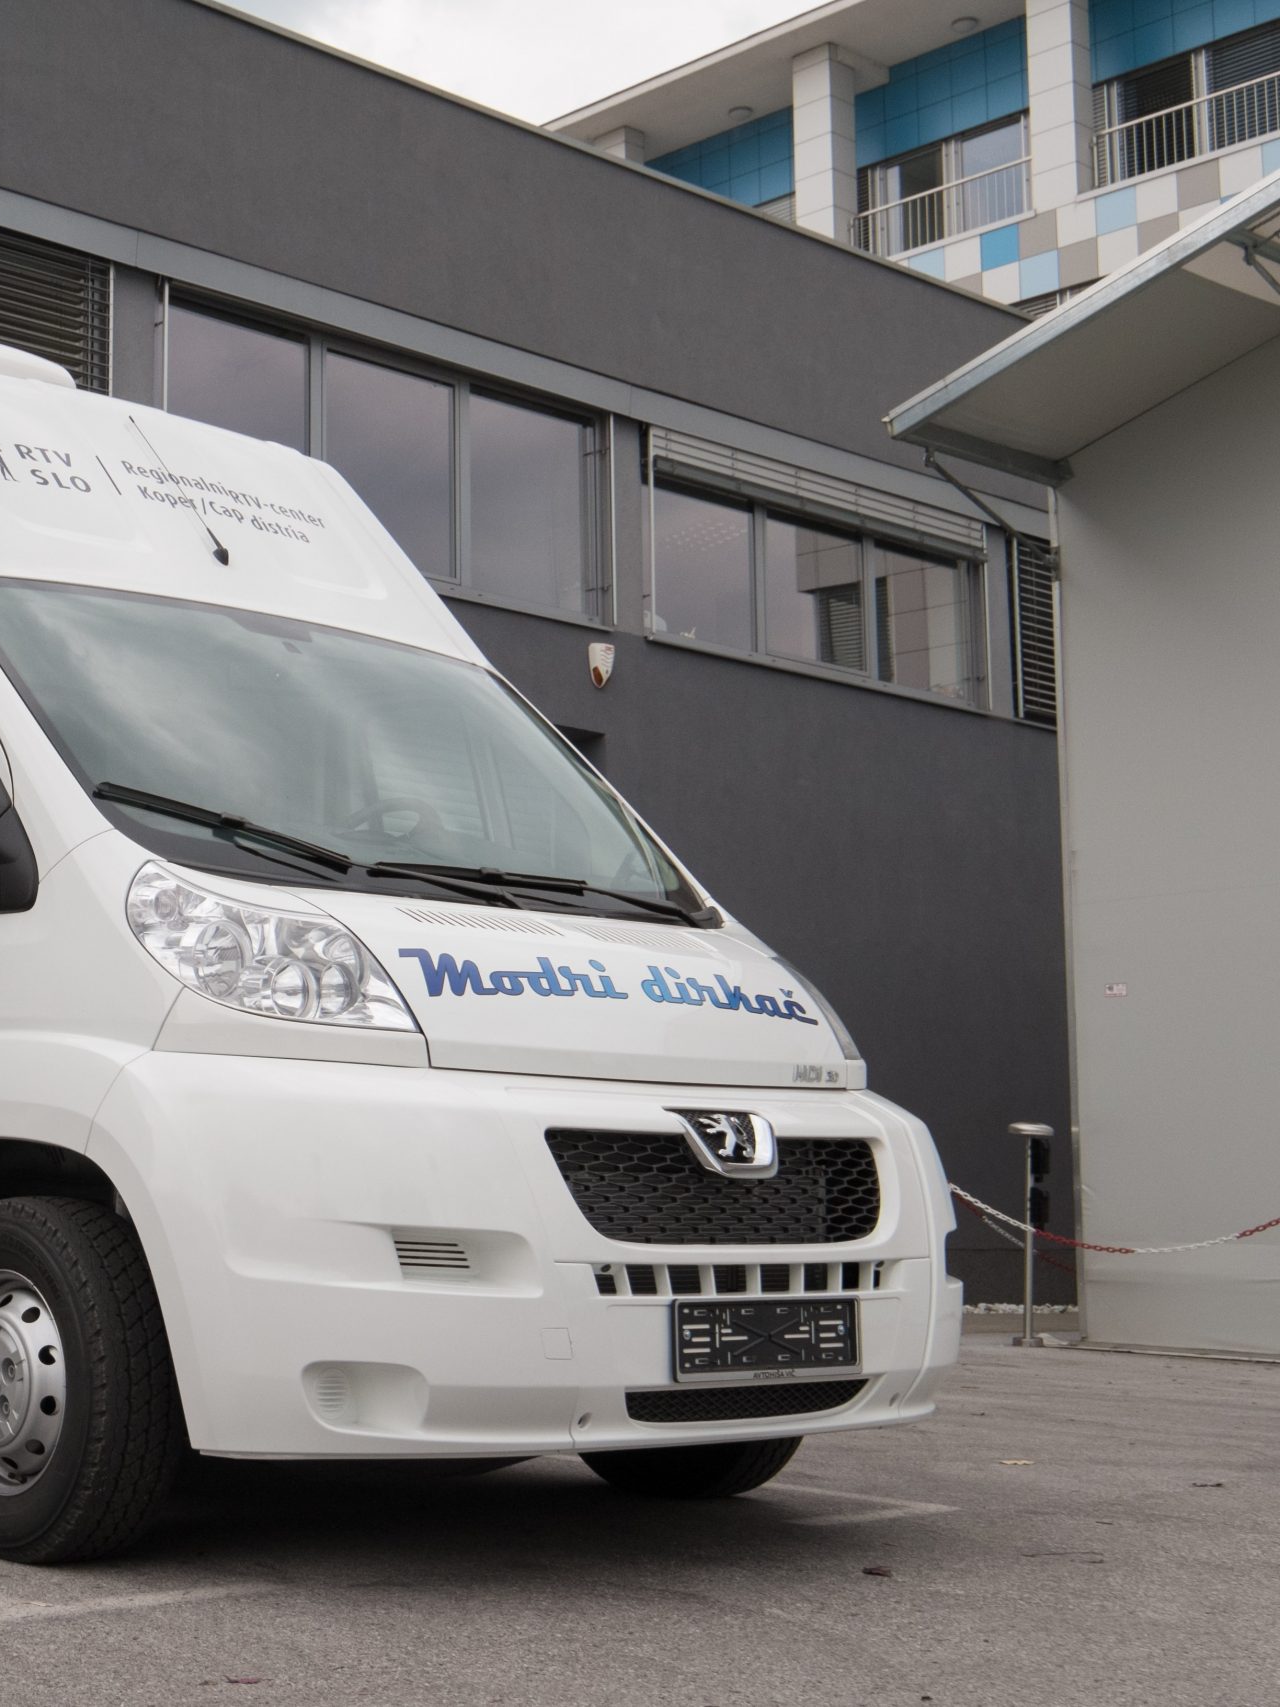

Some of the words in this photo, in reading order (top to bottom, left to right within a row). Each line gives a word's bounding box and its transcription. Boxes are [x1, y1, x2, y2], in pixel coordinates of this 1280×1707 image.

[14, 443, 73, 468] RTV
[30, 469, 92, 494] SLO
[251, 514, 311, 544] distria
[398, 948, 629, 999] Modri
[641, 965, 819, 1026] dirkač
